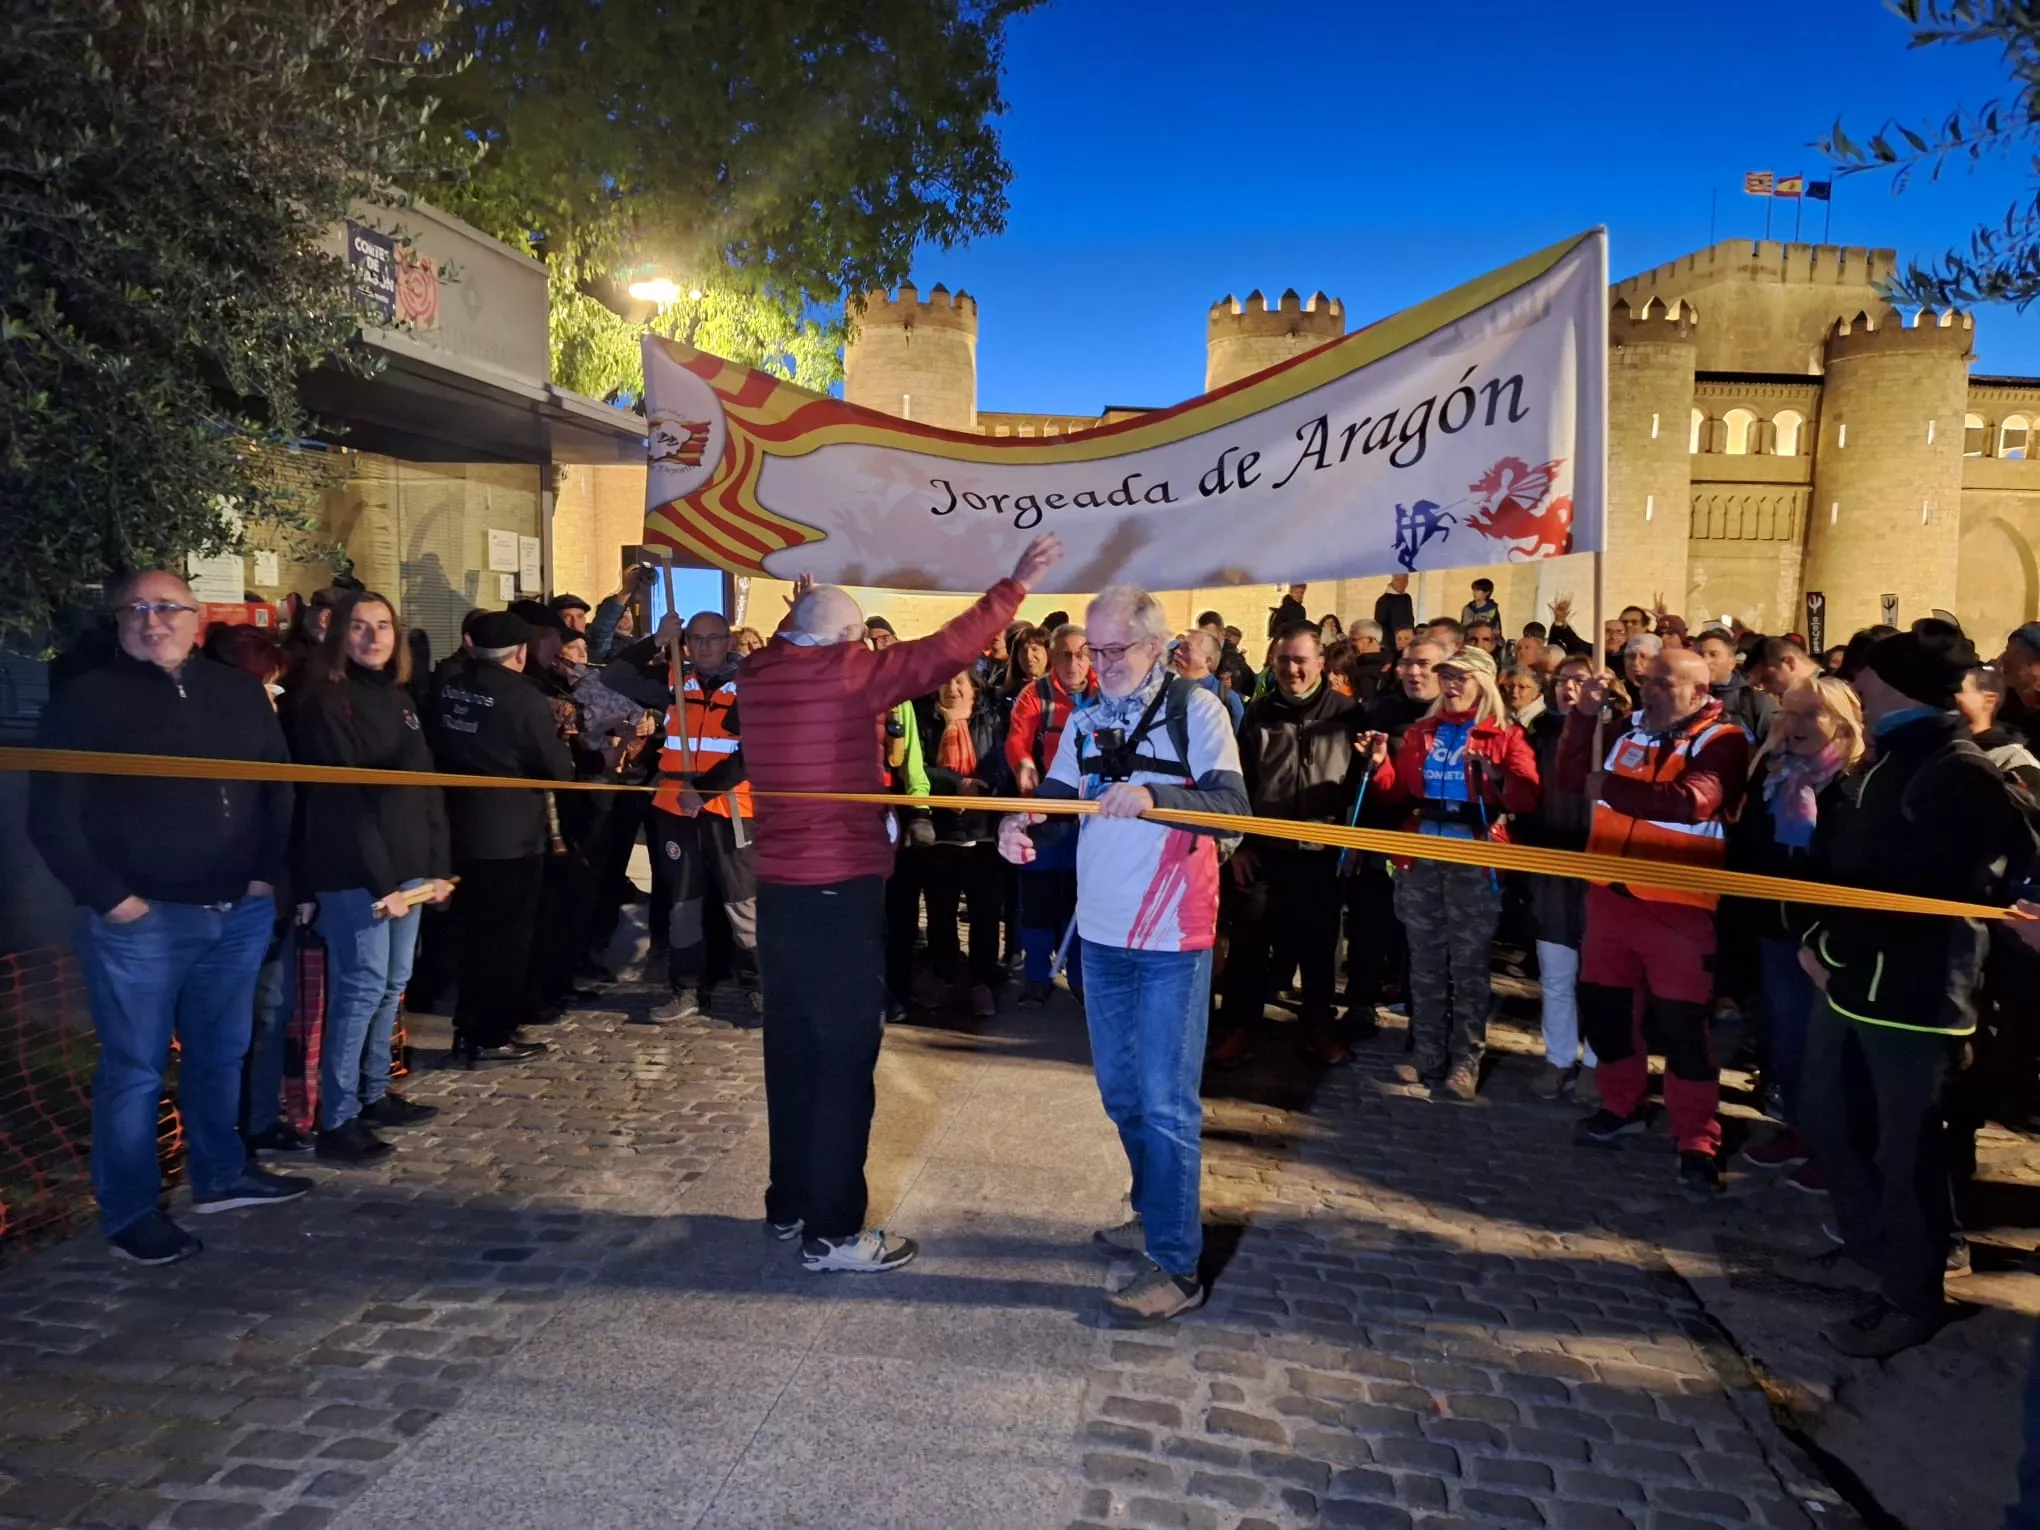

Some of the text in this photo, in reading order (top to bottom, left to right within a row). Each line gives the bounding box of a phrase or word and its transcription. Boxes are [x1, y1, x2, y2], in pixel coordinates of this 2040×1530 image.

[366, 256, 380, 272] DE
[930, 364, 1530, 529] Jorgeada de Aragón
